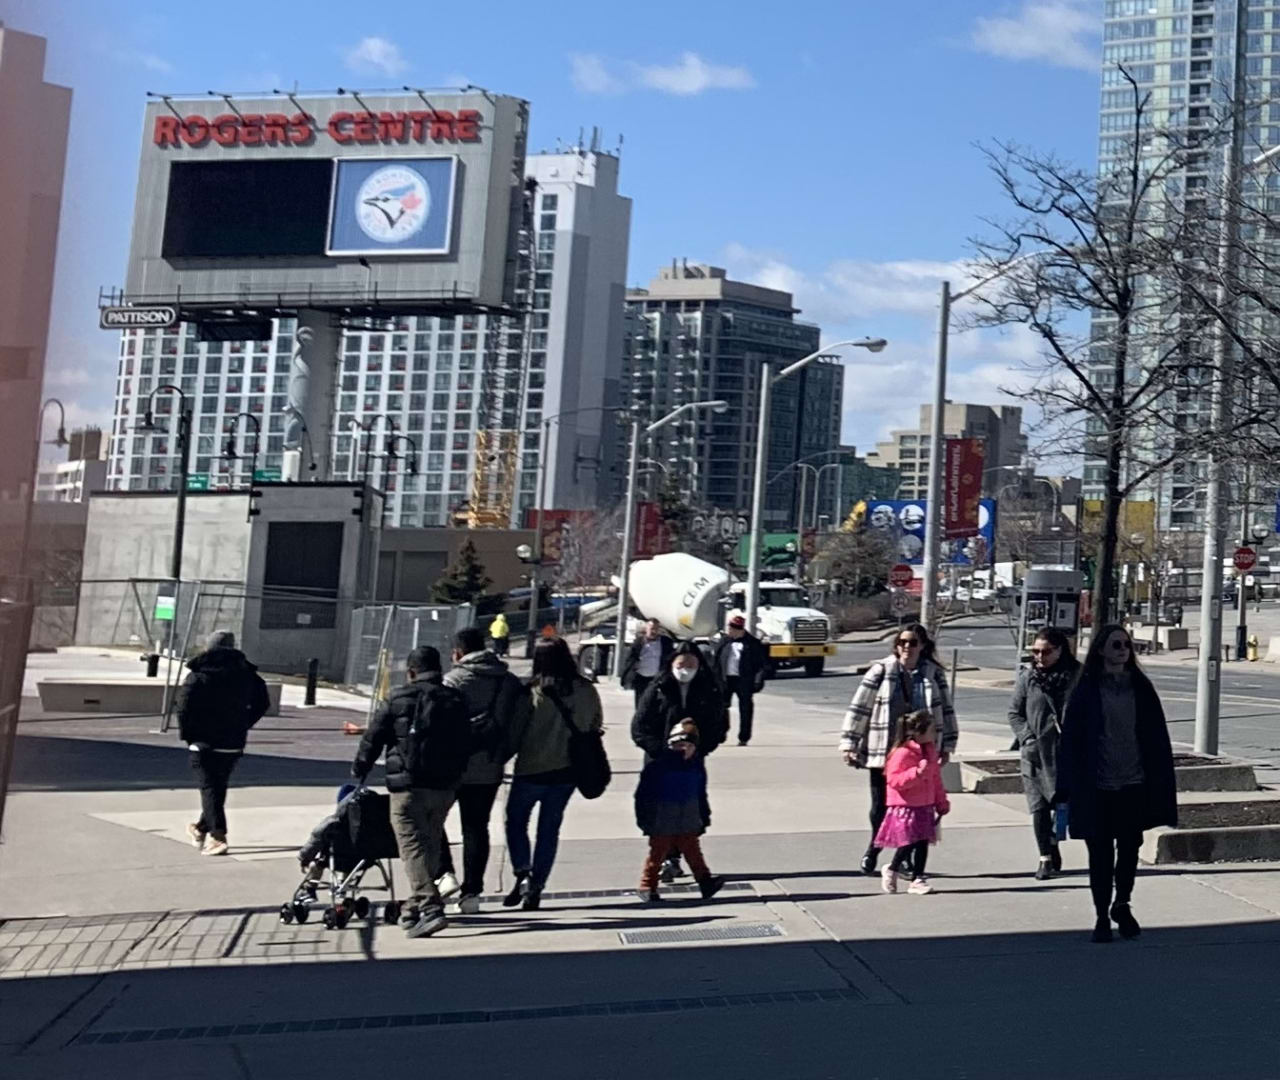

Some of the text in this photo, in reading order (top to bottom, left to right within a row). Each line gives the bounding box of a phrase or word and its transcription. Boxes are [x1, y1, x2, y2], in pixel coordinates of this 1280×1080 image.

[153, 110, 482, 148] ROGERS CENTRE
[107, 311, 170, 323] PATTISON
[1234, 553, 1256, 564] STOP
